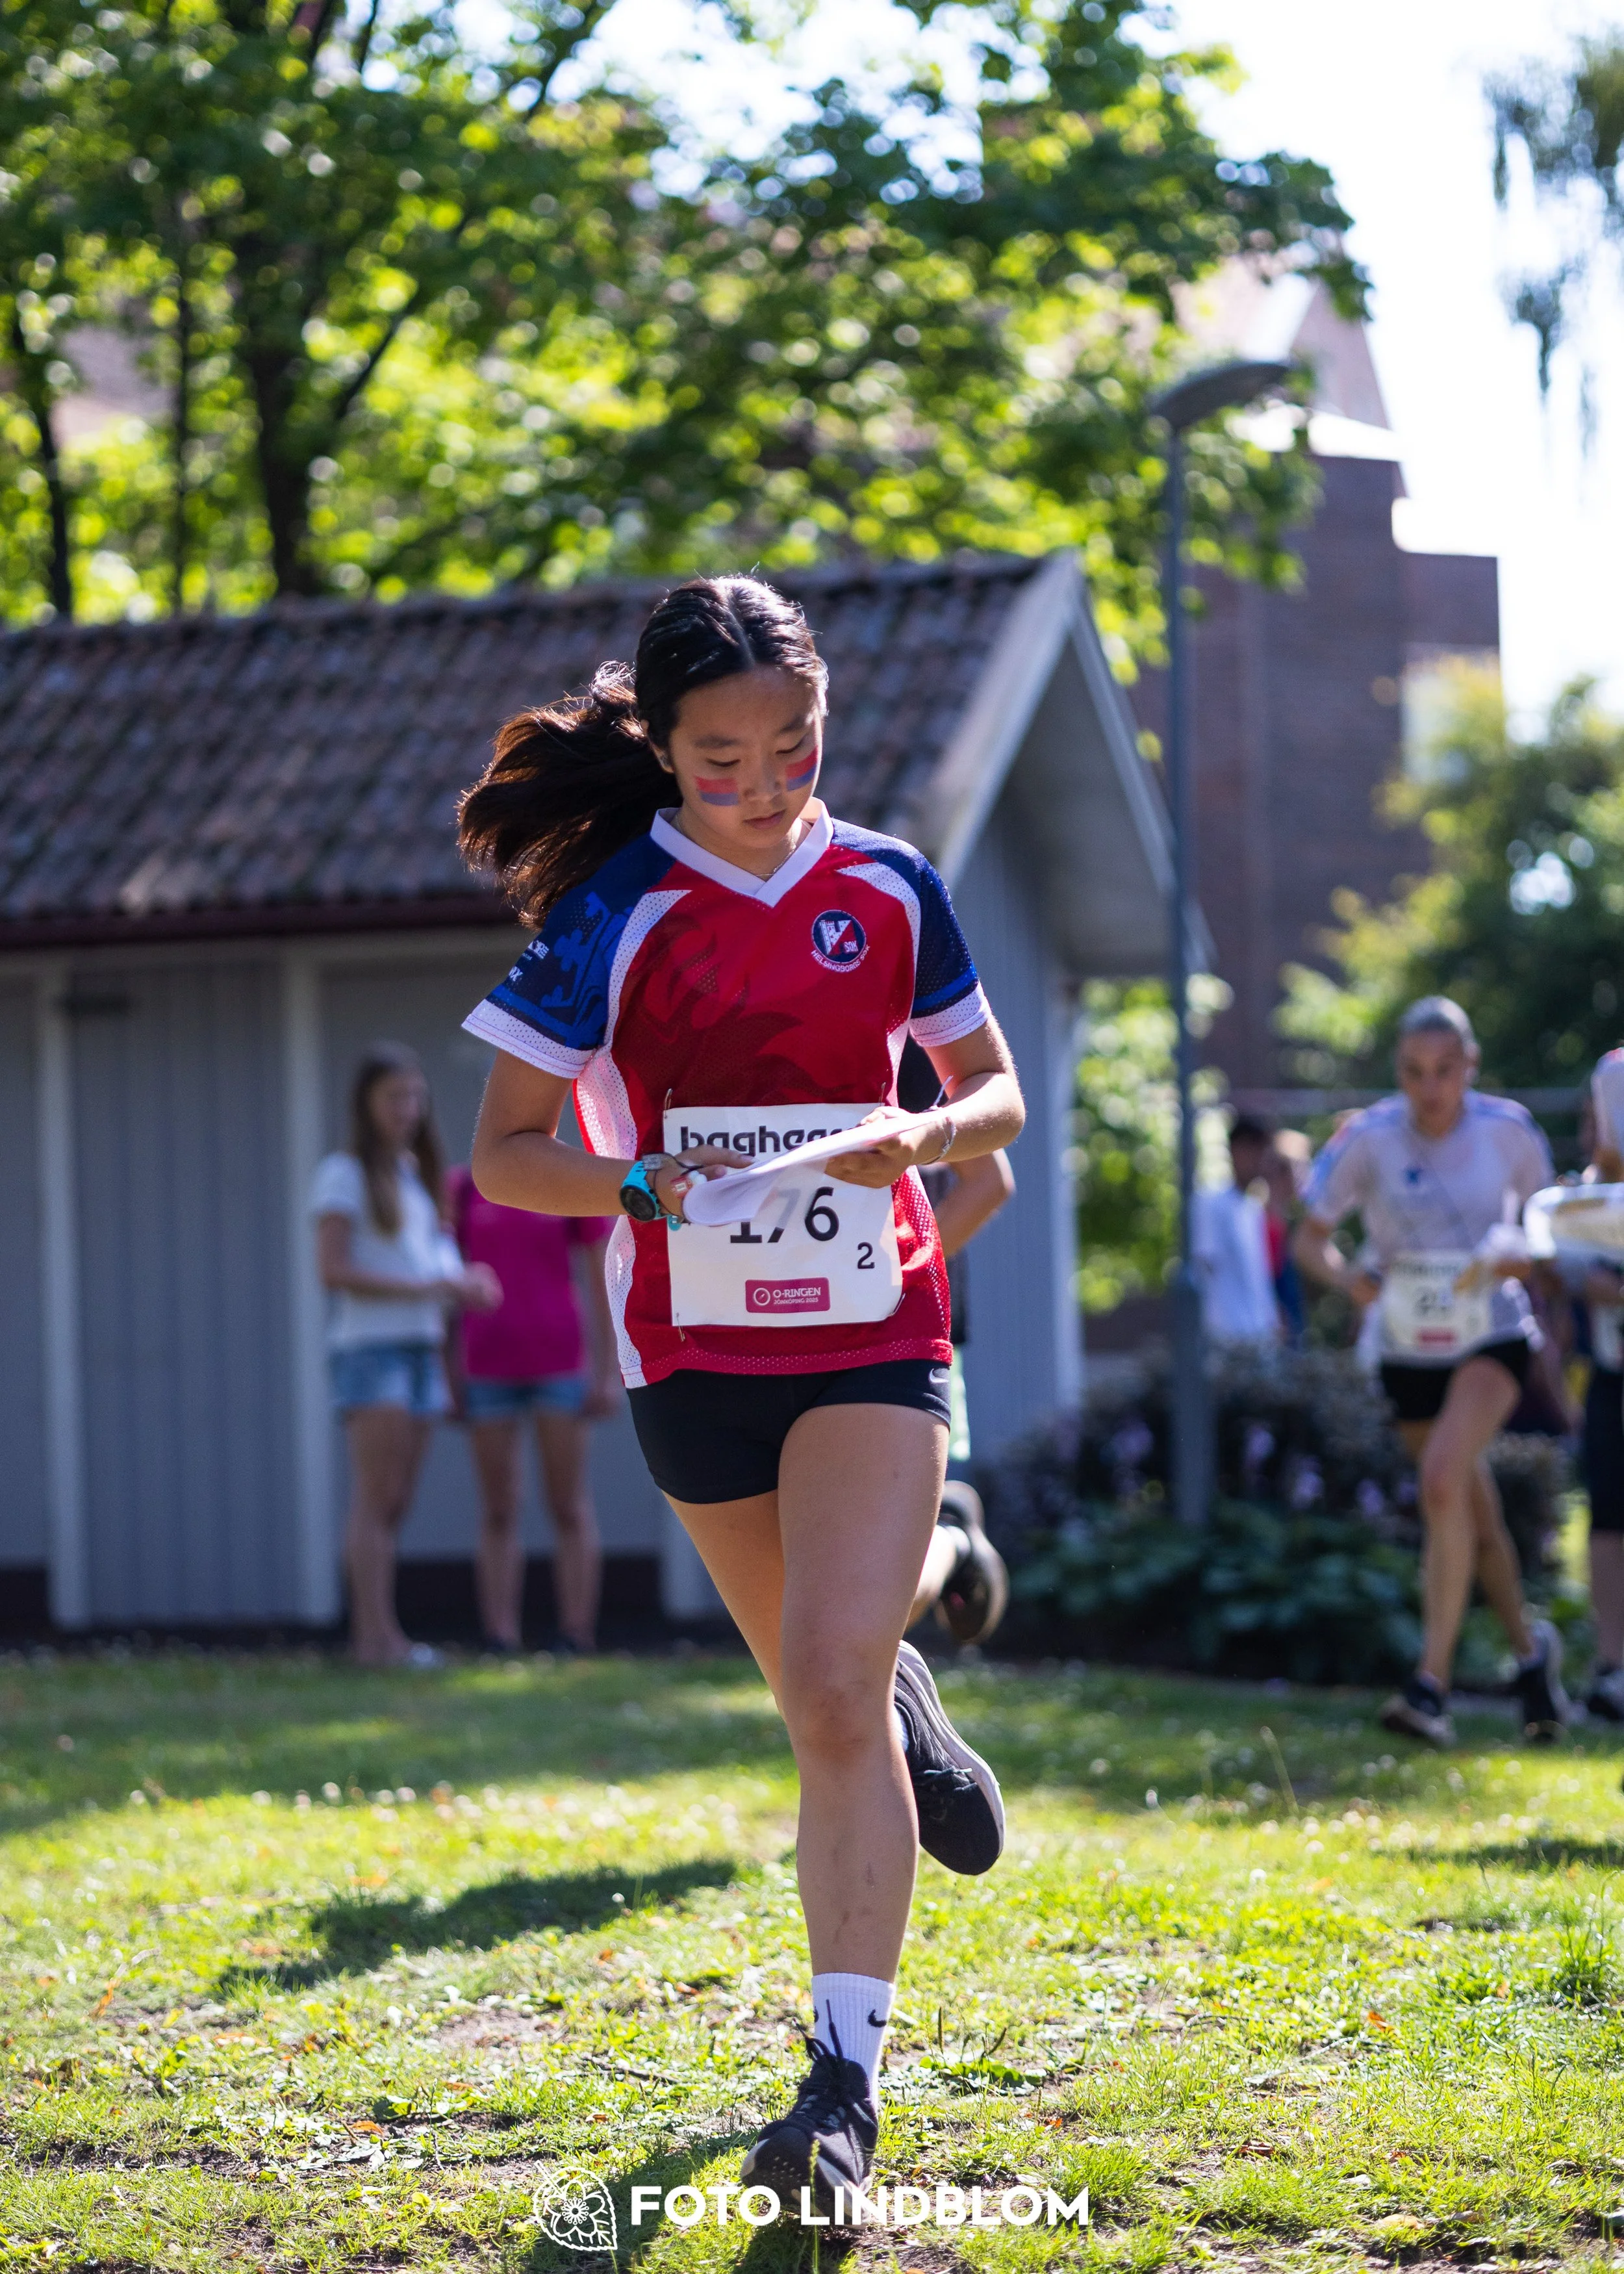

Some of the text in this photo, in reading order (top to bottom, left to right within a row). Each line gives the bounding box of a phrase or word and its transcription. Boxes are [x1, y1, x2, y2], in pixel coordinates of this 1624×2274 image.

[681, 1125, 861, 1157] baghee
[857, 1241, 876, 1270] 2
[772, 1286, 821, 1299] O-RINGEN
